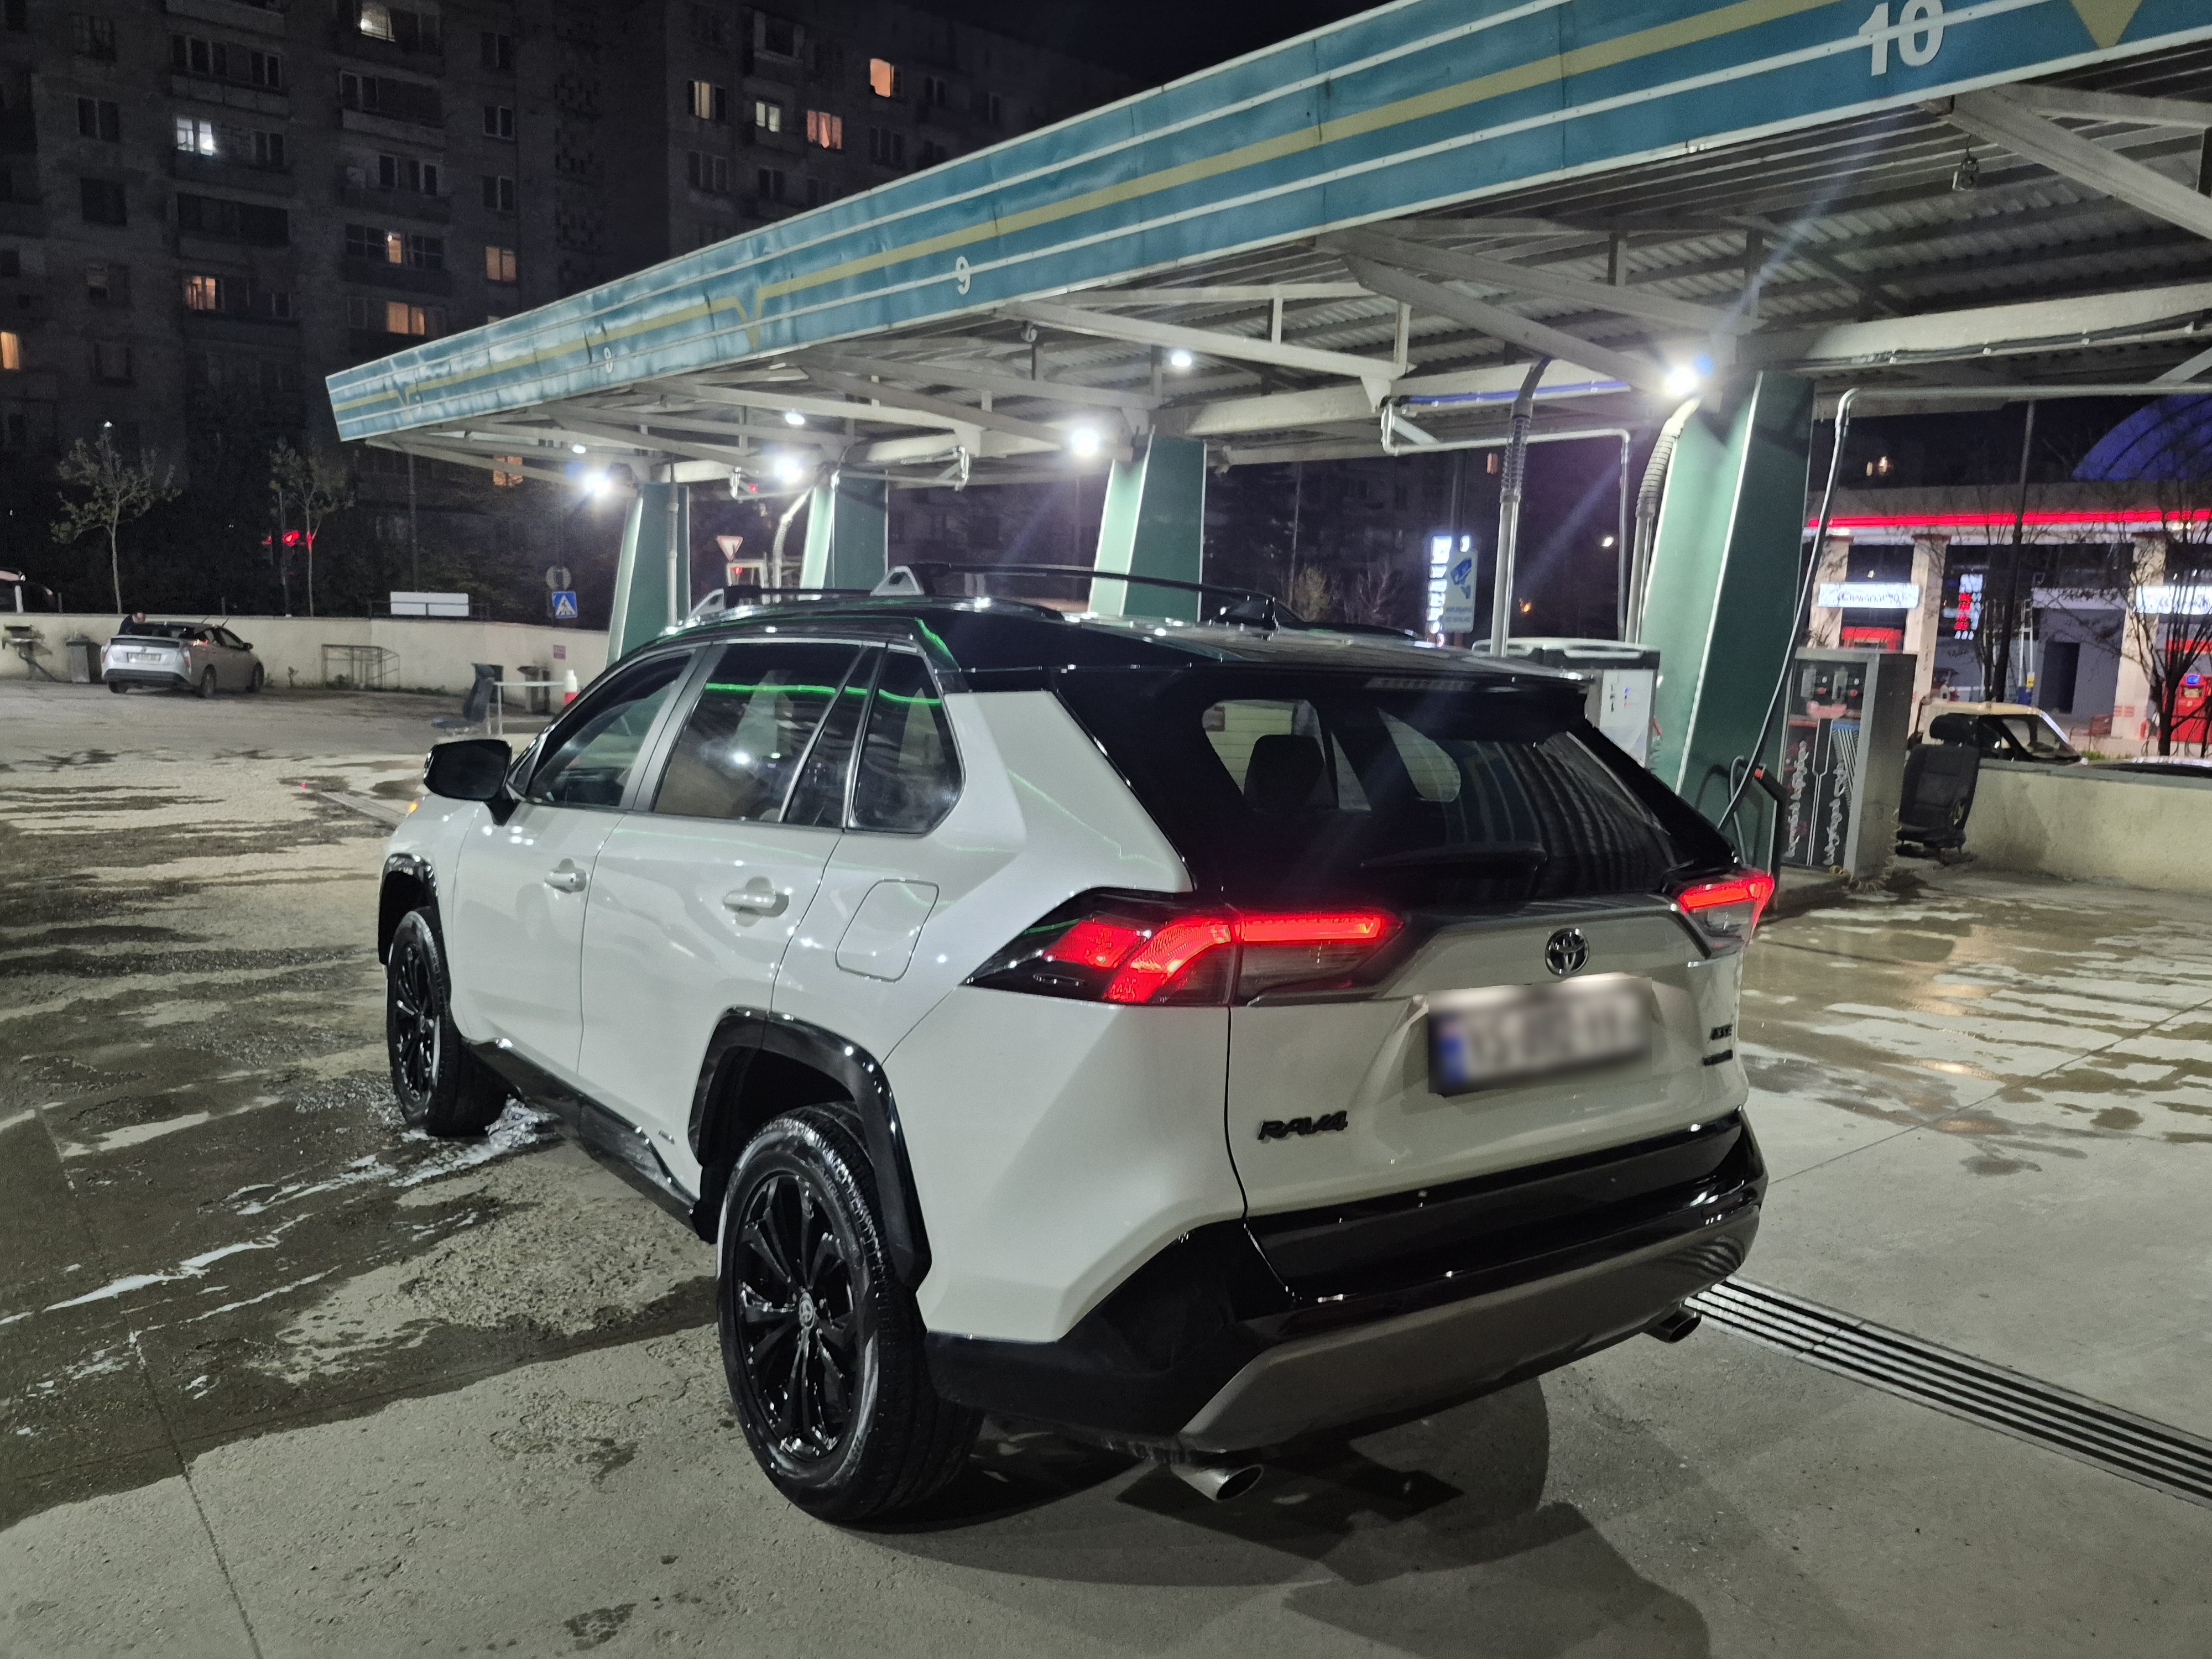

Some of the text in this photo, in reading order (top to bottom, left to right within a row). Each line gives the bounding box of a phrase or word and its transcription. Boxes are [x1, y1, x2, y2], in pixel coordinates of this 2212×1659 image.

[1858, 0, 1944, 76] 10
[956, 256, 971, 295] 9
[1257, 1109, 1348, 1140] RAV4
